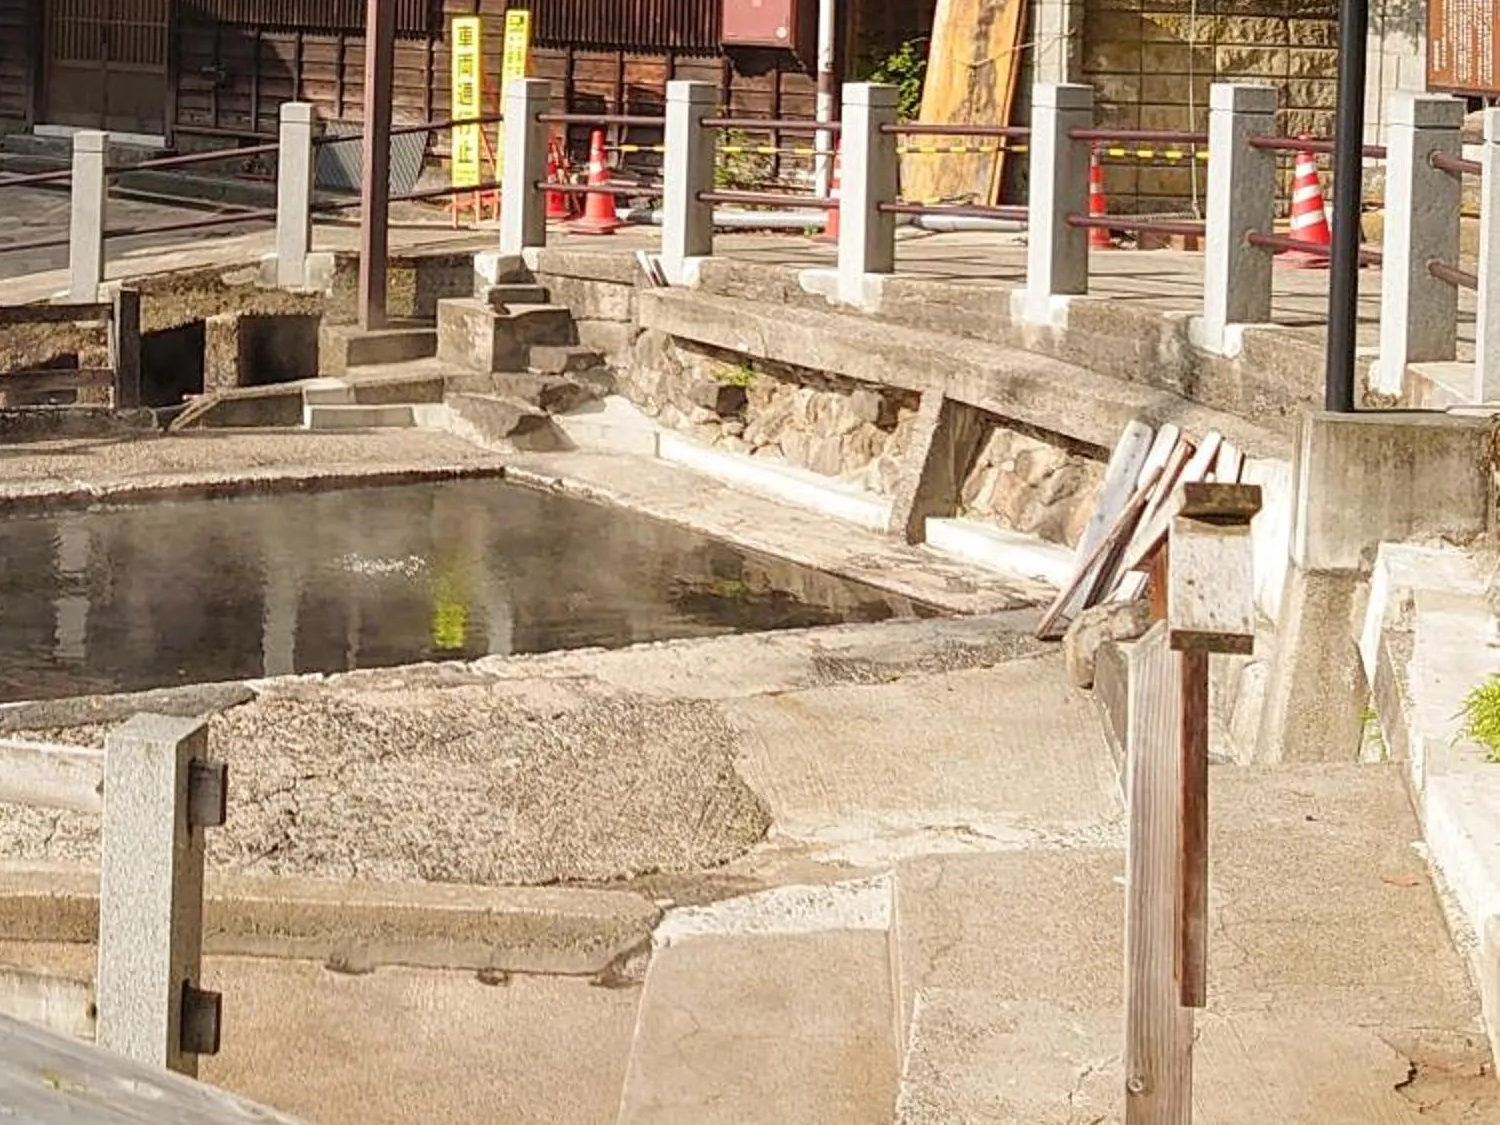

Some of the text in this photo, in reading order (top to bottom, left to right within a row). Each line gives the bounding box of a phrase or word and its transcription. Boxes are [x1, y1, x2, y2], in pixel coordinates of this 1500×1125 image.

[457, 26, 473, 164] 車両通行止
